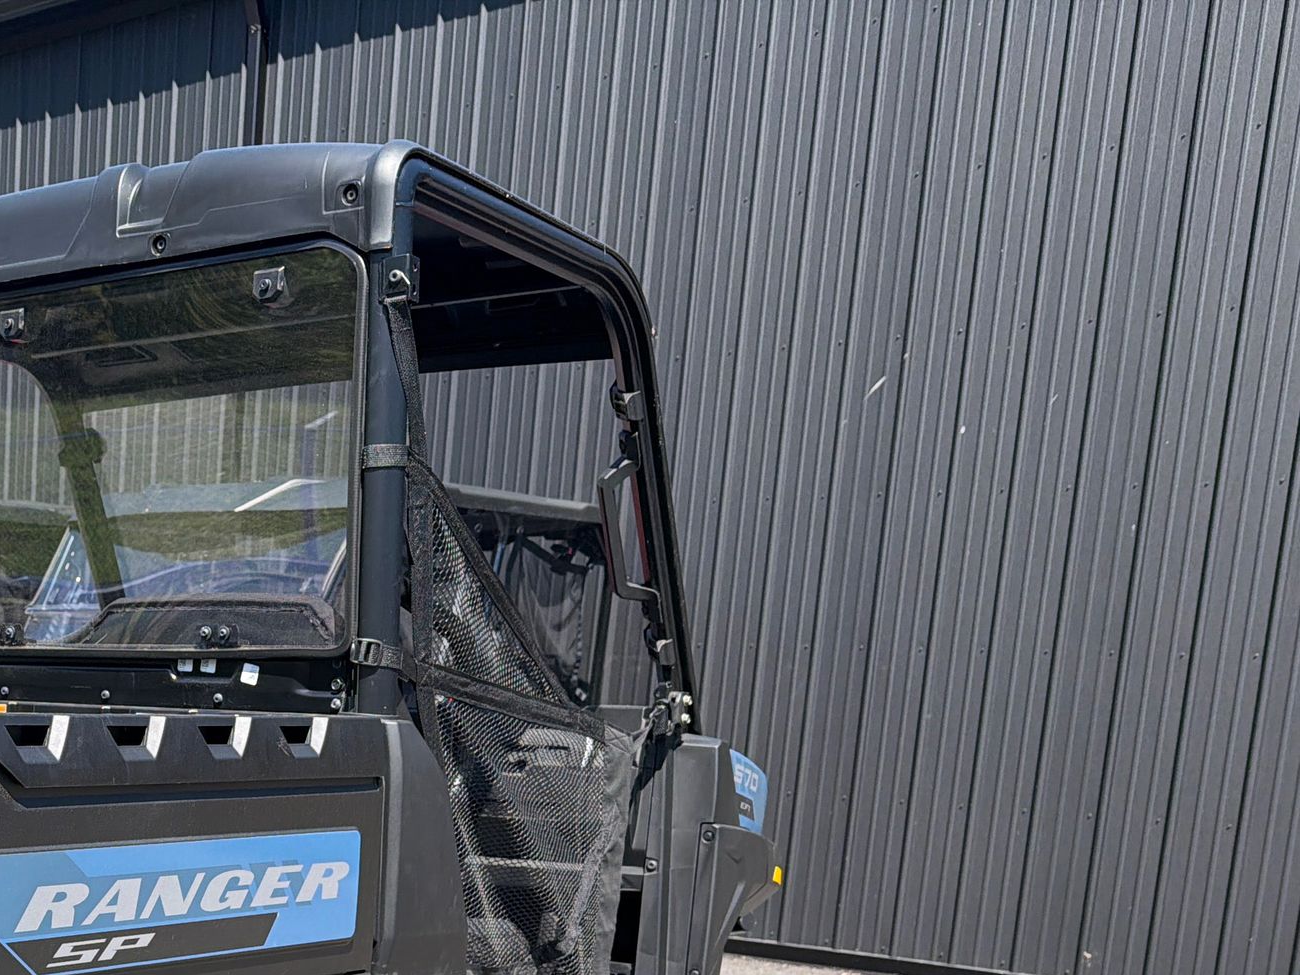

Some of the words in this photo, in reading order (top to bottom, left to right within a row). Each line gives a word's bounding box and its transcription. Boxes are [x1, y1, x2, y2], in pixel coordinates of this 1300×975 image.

[734, 763, 759, 793] 570
[14, 861, 350, 934] RANGER
[46, 932, 156, 968] SP
